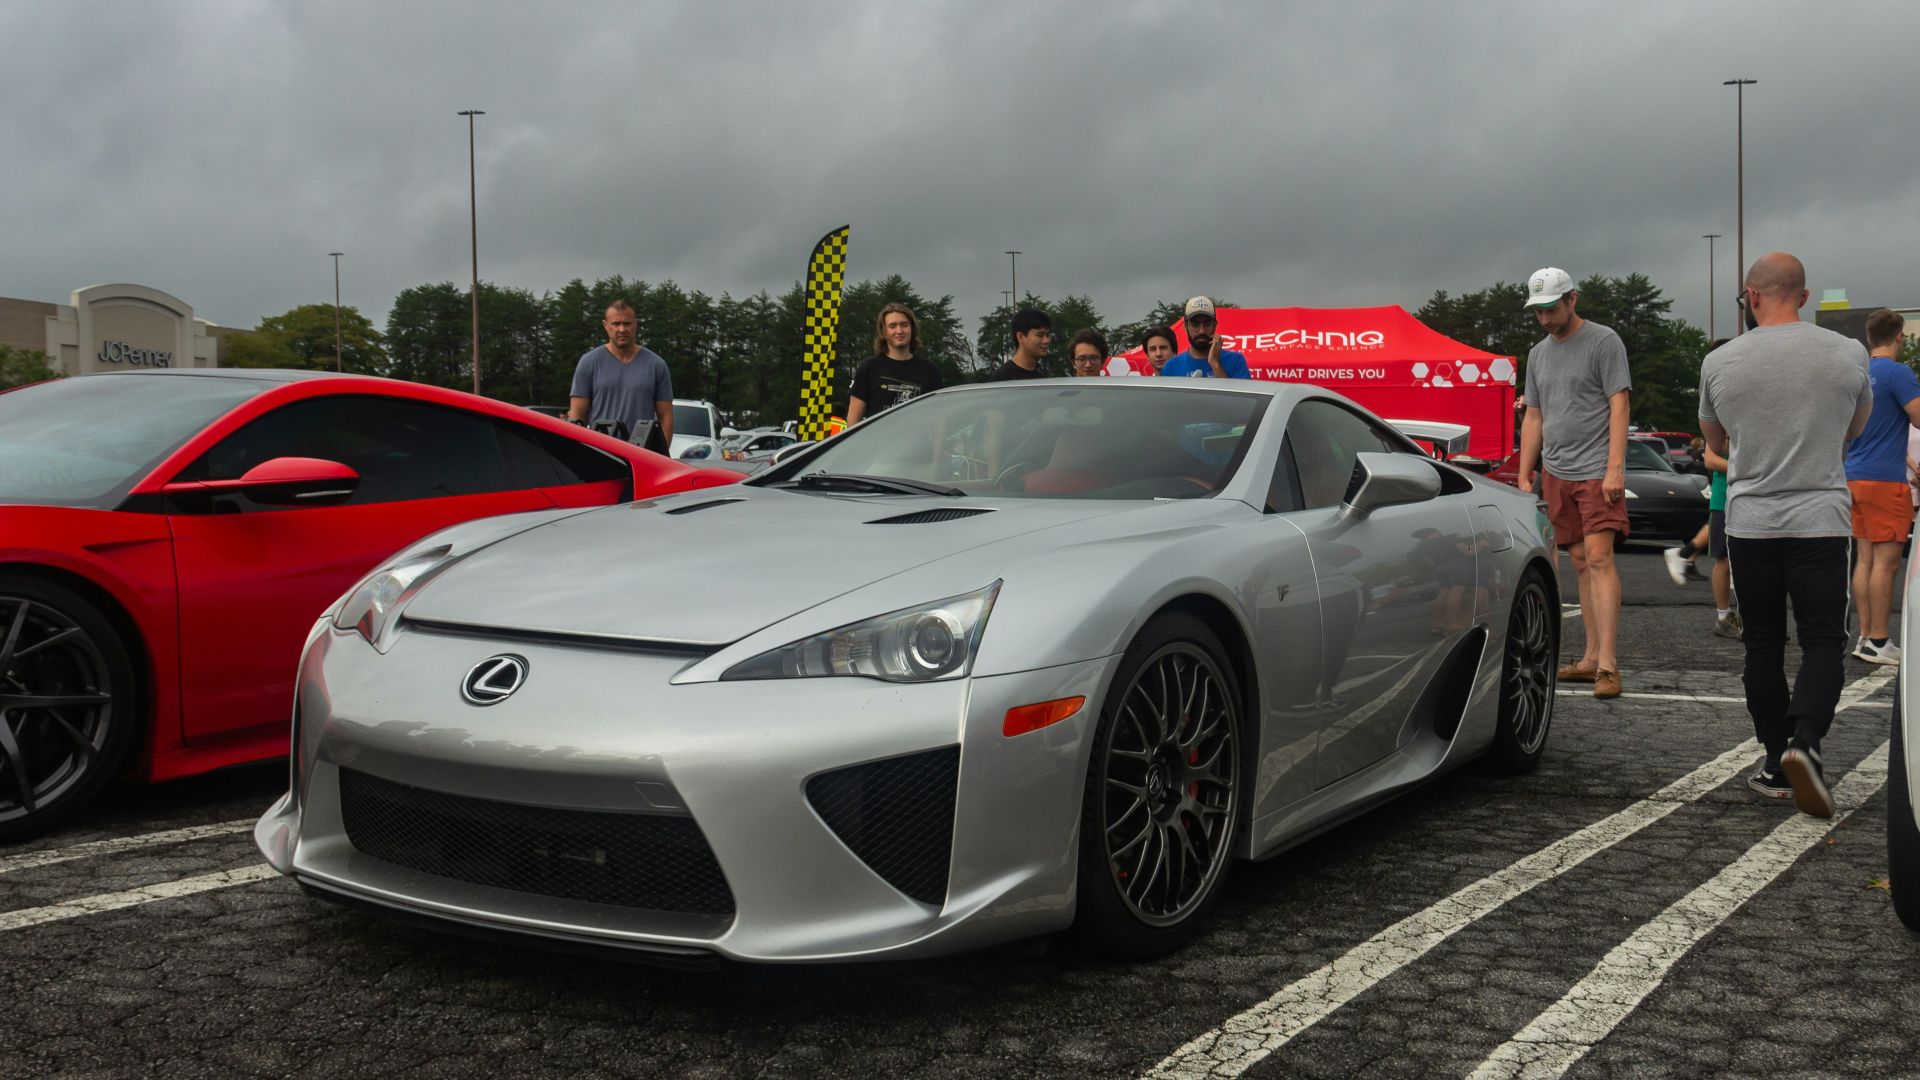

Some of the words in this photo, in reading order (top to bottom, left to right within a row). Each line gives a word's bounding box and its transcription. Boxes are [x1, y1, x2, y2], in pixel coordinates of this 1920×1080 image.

[1261, 343, 1321, 352] SURFACE
[1328, 343, 1386, 351] SCIENCE
[98, 340, 173, 368] JCPenney
[1265, 368, 1305, 379] WHAT
[1308, 368, 1354, 379] DRIVES
[1358, 368, 1386, 379] YOU
